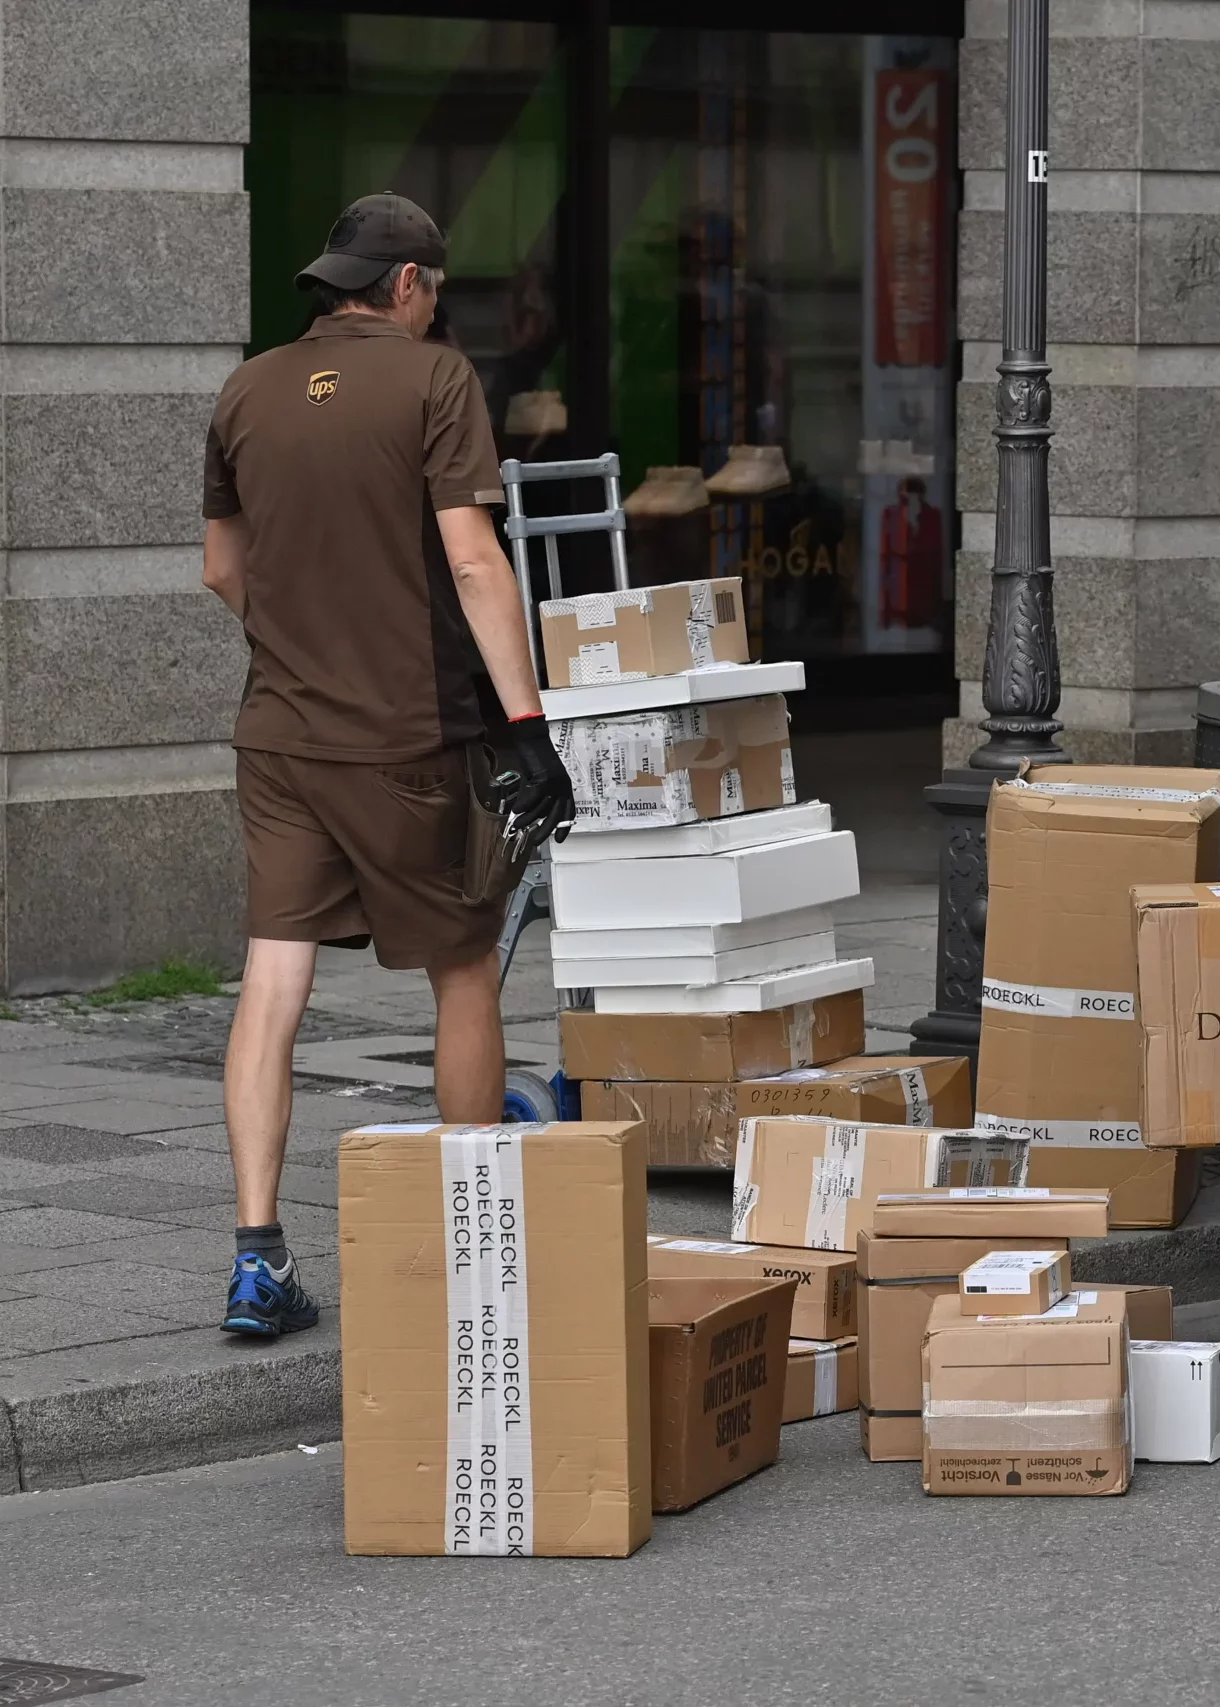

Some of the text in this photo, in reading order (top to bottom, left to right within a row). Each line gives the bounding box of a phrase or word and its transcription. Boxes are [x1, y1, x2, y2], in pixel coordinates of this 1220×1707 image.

[309, 380, 336, 400] ups
[576, 806, 601, 818] Maxi
[617, 799, 657, 811] Maxima
[982, 985, 1135, 1014] ROECKL ROEC
[751, 1088, 831, 1103] 0301359
[1088, 1128, 1139, 1142] ROEC
[452, 1181, 471, 1274] ROECKL
[475, 1165, 495, 1259] ROECKL
[498, 1198, 517, 1292] ROECKL
[457, 1320, 473, 1413] ROECKL
[481, 1305, 497, 1398] ROECKL
[709, 1318, 755, 1370] PROPERTY
[502, 1338, 521, 1432] ROECKL
[703, 1352, 768, 1415] UNITED PARCEL
[716, 1399, 752, 1448] SERVICE
[940, 1458, 1002, 1467] zerbrechlich!
[941, 1470, 1001, 1483] Vorsicht
[1026, 1471, 1084, 1482] Vor Nässe
[1027, 1457, 1082, 1468] schützen!
[454, 1459, 472, 1551] ROECKL
[480, 1444, 496, 1537] ROECKL
[507, 1477, 524, 1556] ROECK
